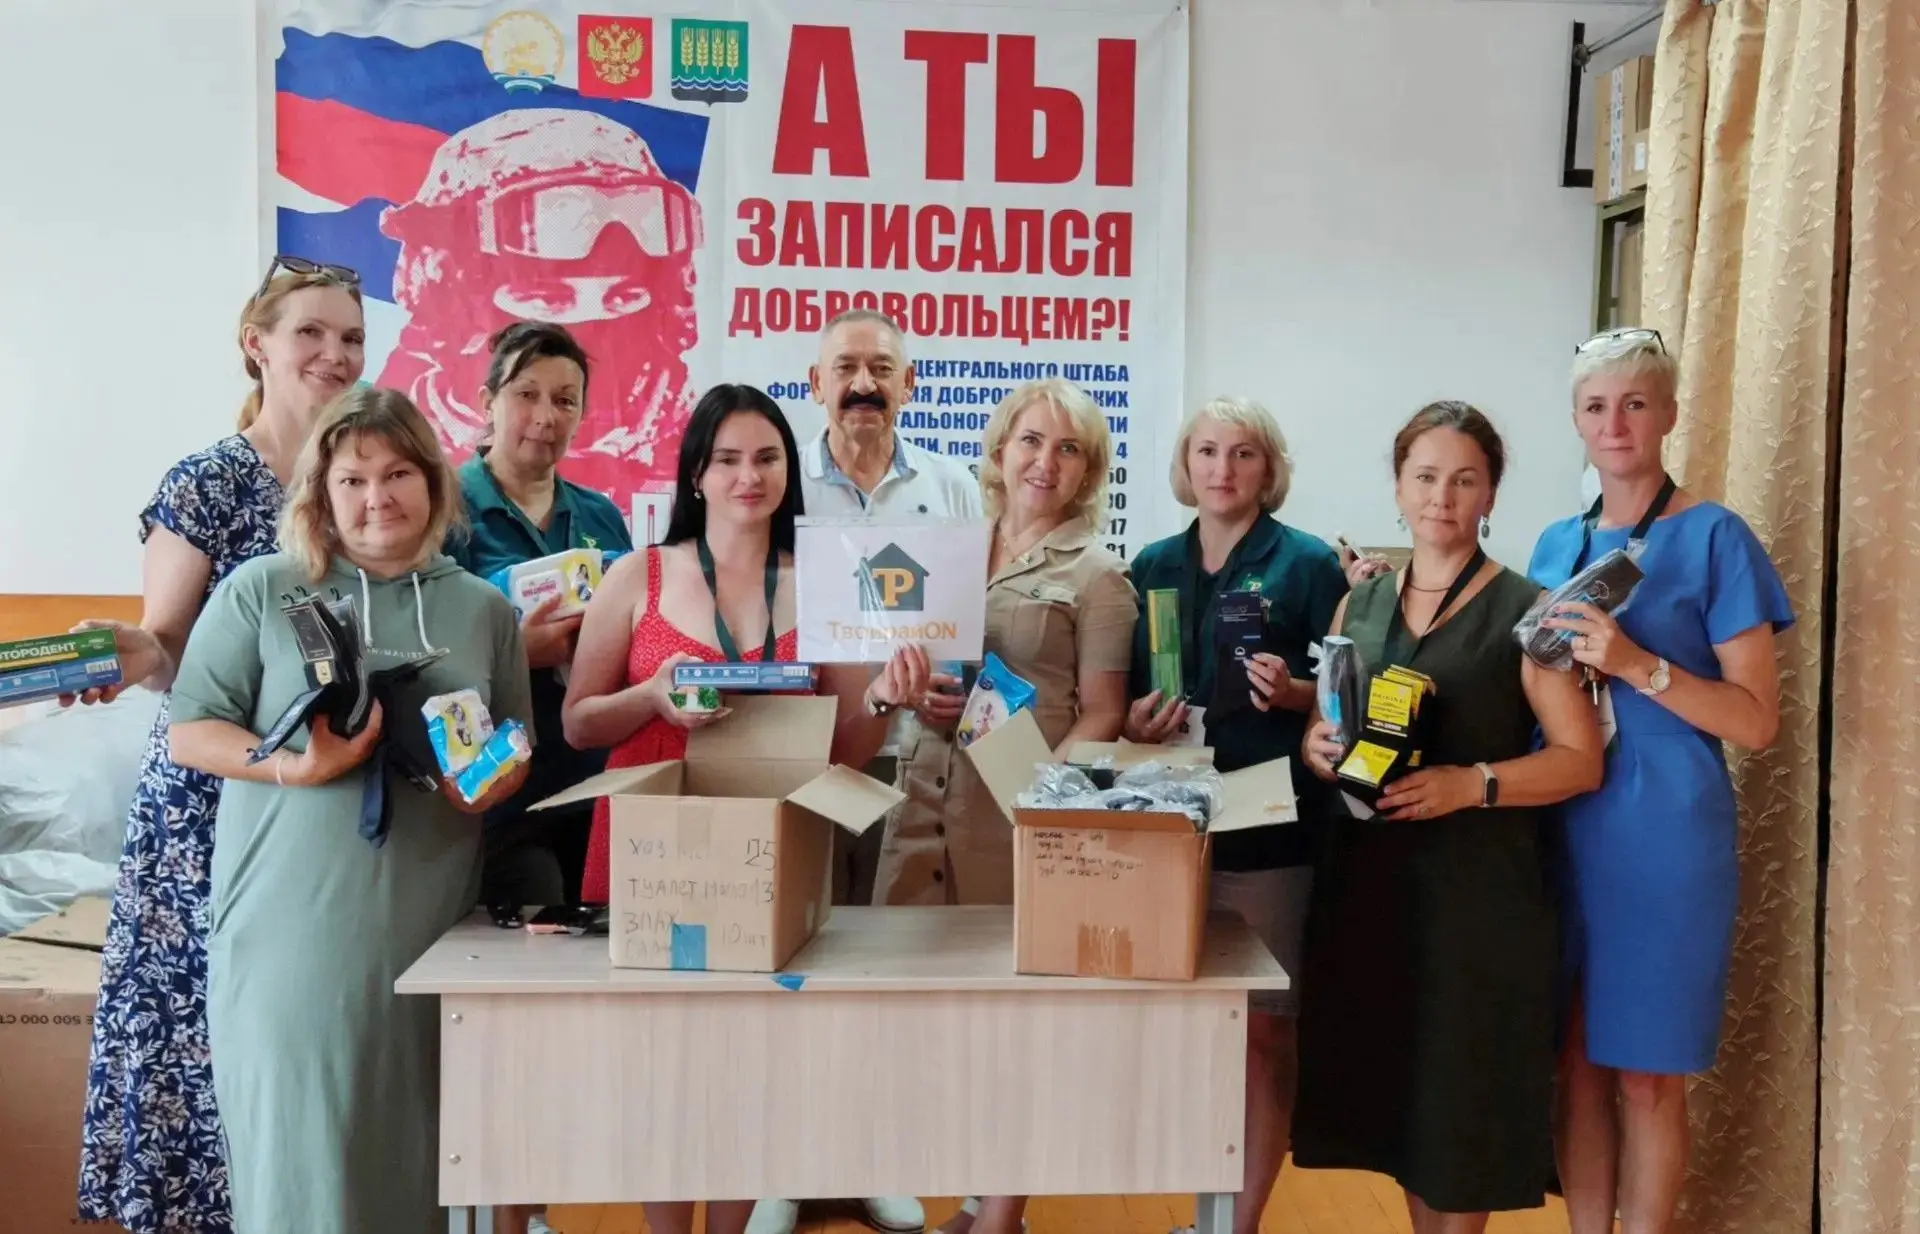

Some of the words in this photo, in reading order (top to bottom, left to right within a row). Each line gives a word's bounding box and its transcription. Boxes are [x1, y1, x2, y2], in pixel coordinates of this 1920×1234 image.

[772, 24, 869, 178] А
[904, 30, 1136, 187] ТЫ
[736, 197, 1132, 278] ЗАПИСАЛСЯ
[912, 359, 1058, 380] ЦЕНТРАЛЬНОГО
[1063, 363, 1129, 382] ШТАБА
[767, 381, 810, 400] ФОР
[0, 641, 76, 661] ТОРОДЕНТ
